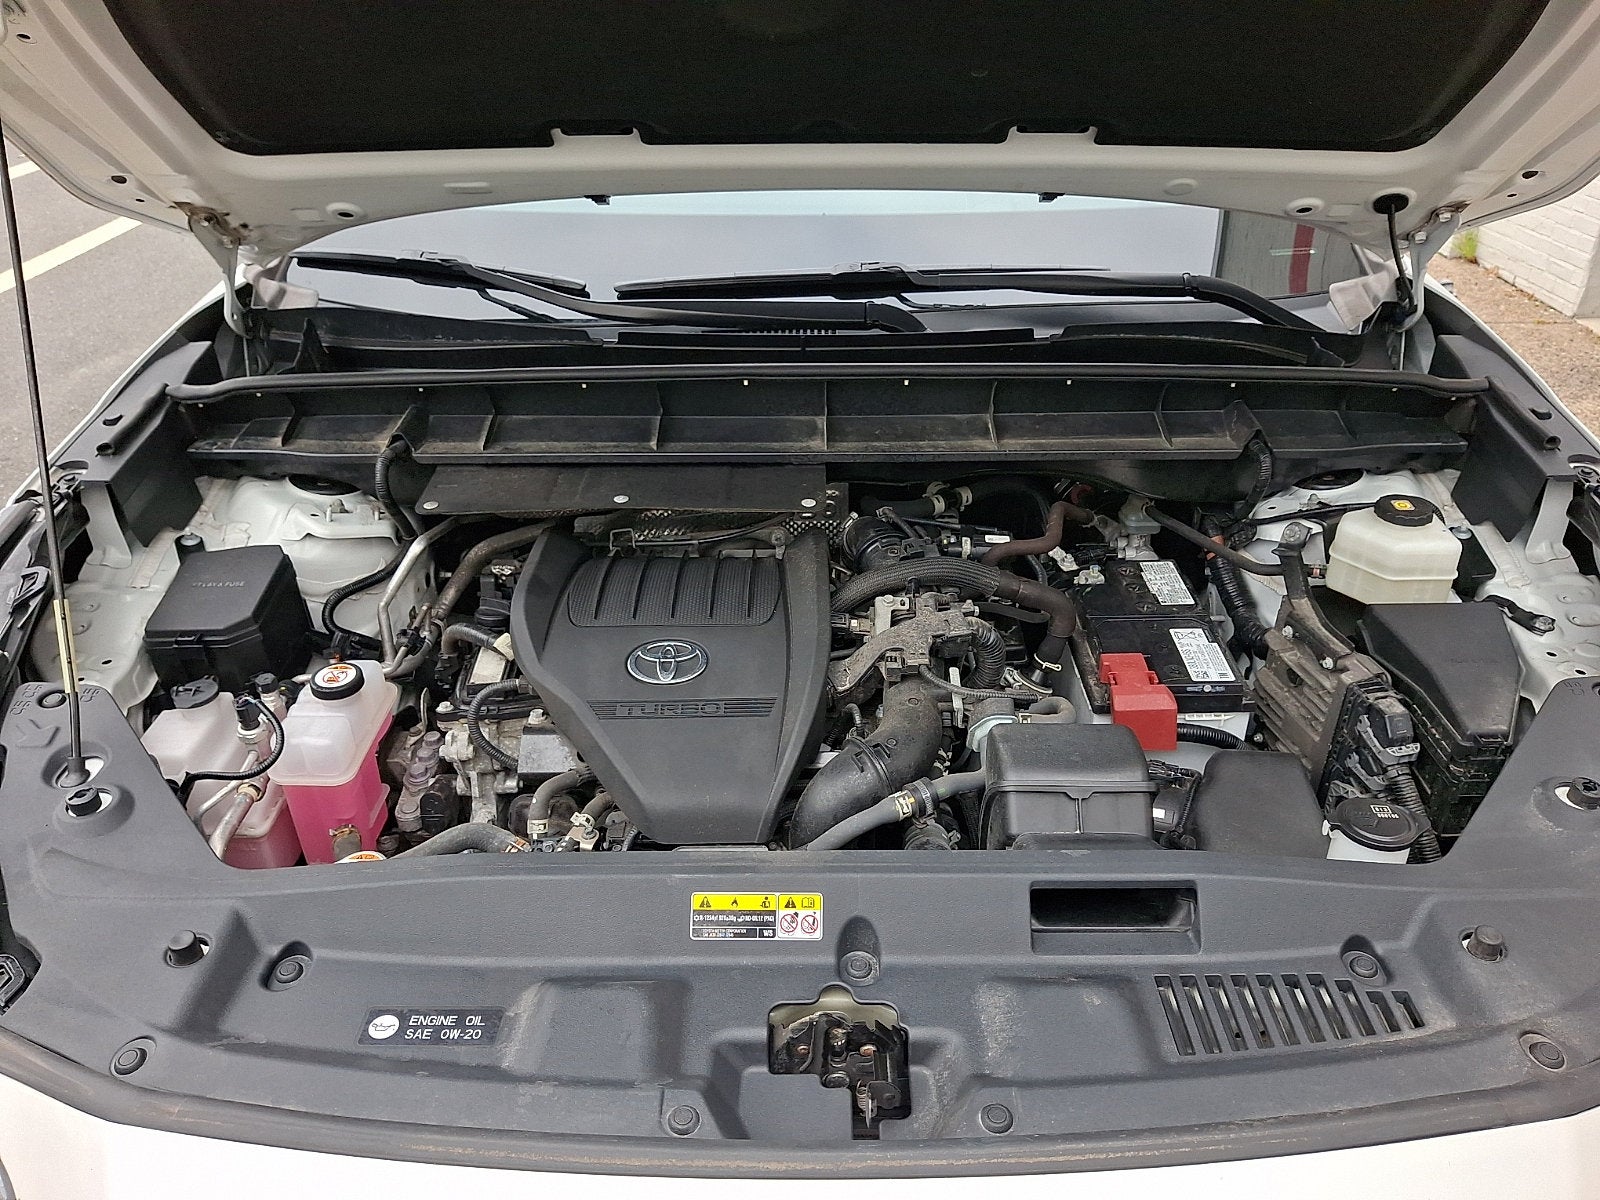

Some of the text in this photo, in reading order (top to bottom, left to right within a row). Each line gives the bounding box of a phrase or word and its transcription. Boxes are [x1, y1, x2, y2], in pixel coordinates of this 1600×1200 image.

[616, 702, 721, 716] TURBO
[408, 1015, 486, 1026] ENGINE OIL
[404, 1028, 482, 1040] SAE 0W-20
